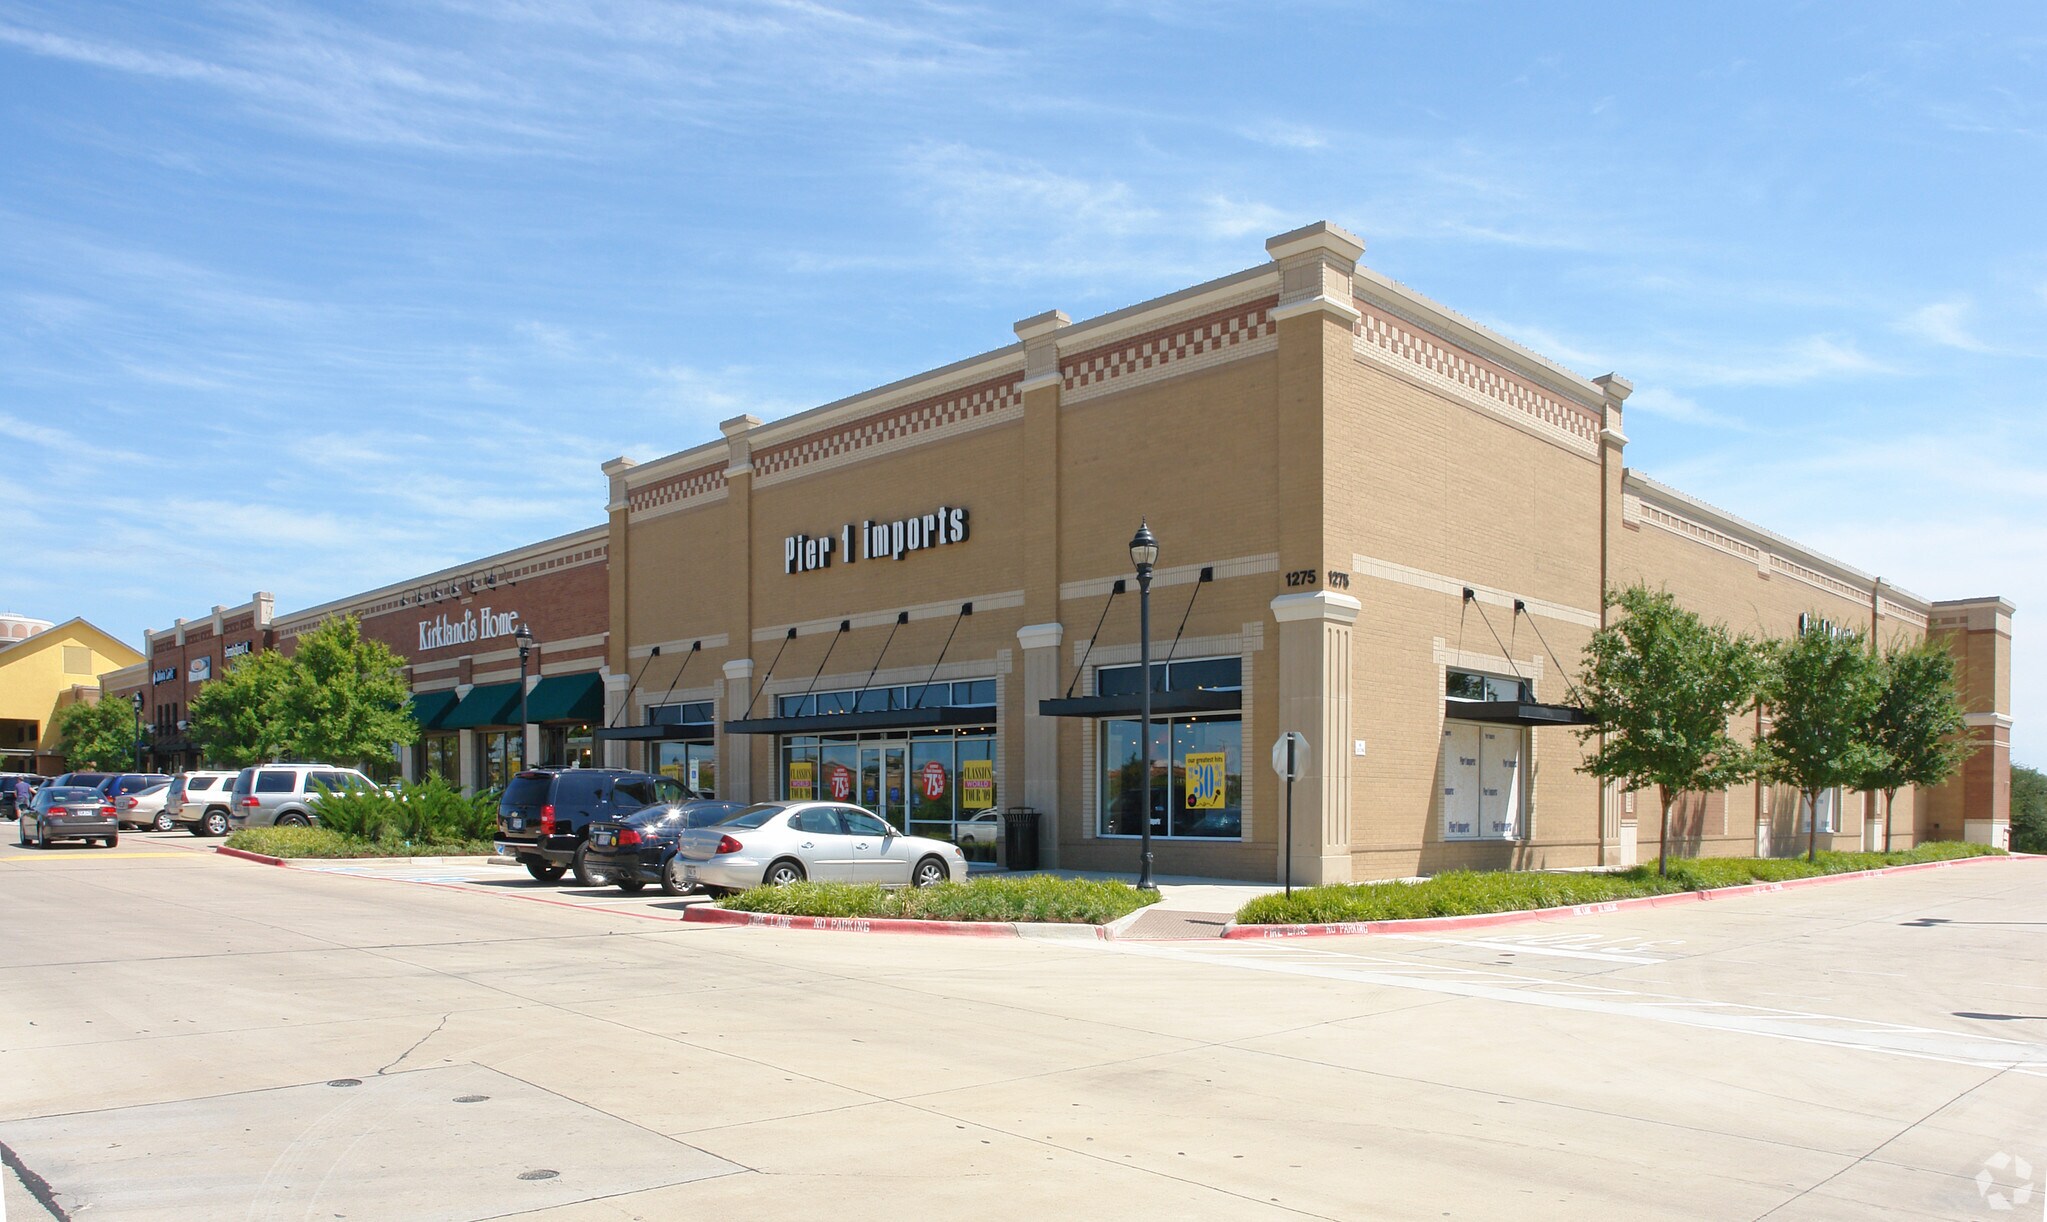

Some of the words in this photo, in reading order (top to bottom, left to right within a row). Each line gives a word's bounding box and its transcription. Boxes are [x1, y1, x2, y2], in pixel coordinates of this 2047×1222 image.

[784, 534, 834, 574] Pier
[842, 524, 854, 563] 1
[863, 506, 968, 560] imports
[1286, 569, 1316, 587] 1275
[1328, 570, 1350, 591] 1275
[419, 608, 477, 651] Kirkland's
[480, 607, 519, 640] Home
[964, 766, 992, 780] CLASSICS
[965, 788, 981, 802] TOUR
[770, 916, 792, 929] LANE
[813, 917, 826, 929] NO
[830, 918, 870, 933] PARKING
[1264, 926, 1283, 938] FIRE
[1326, 924, 1336, 934] NO
[1340, 922, 1369, 934] PARKING
